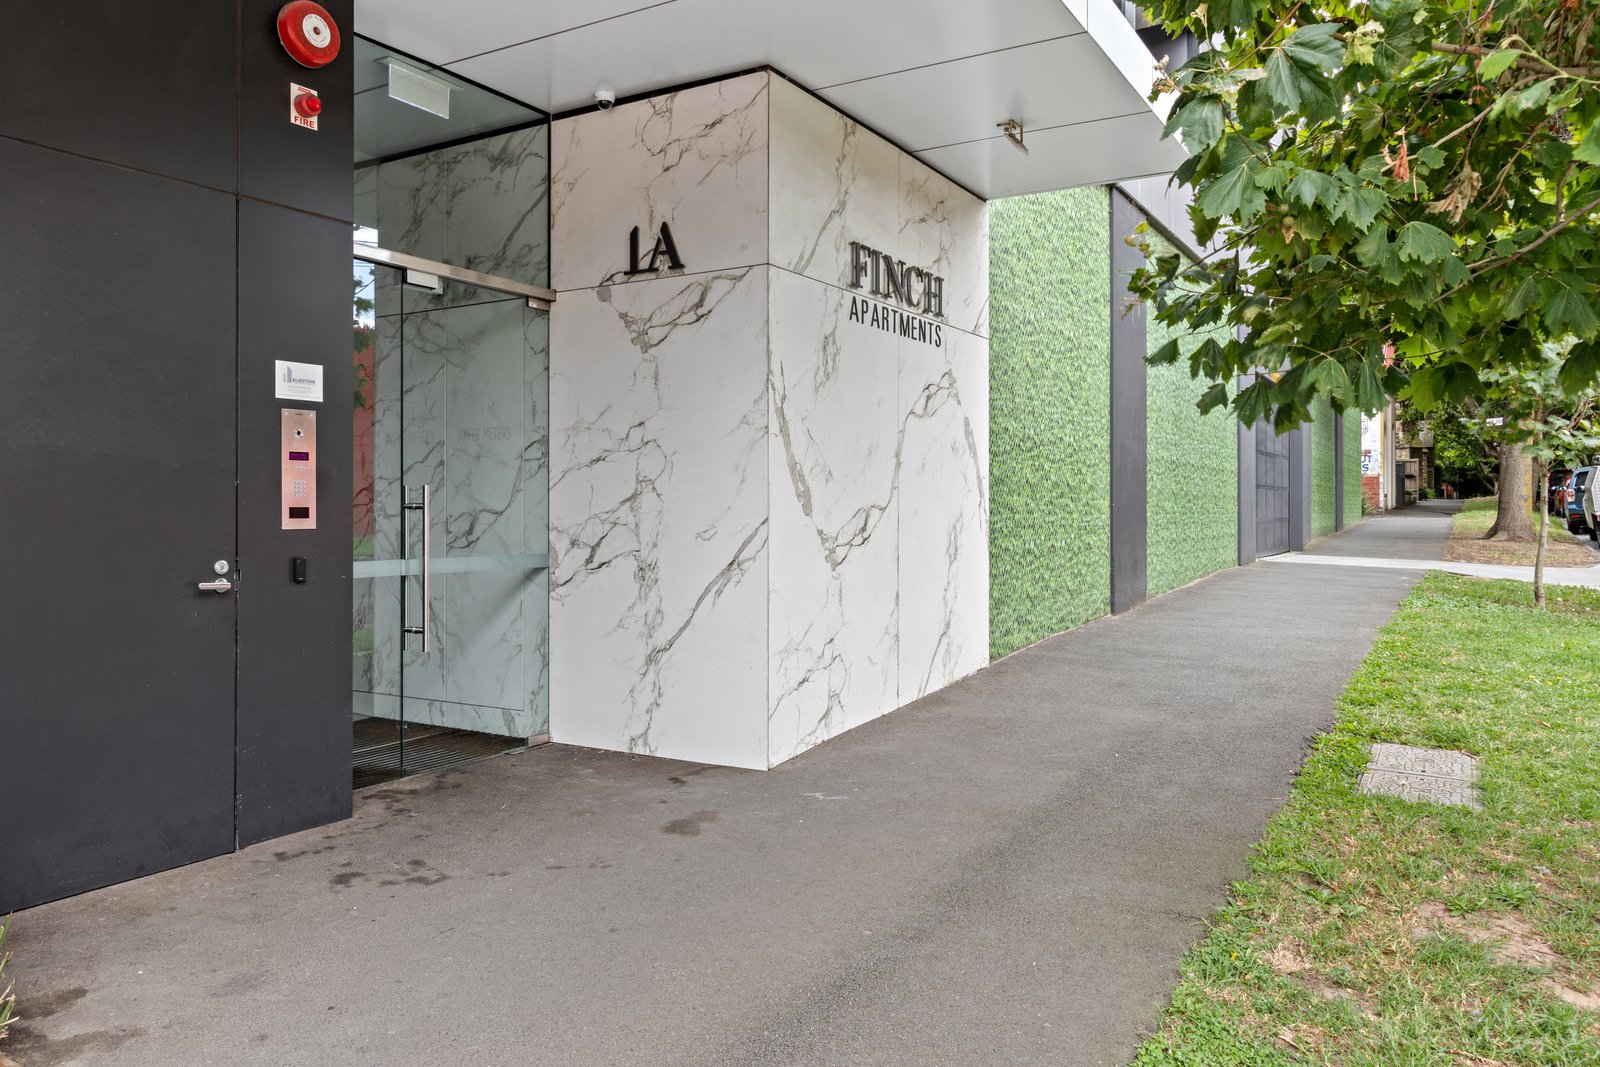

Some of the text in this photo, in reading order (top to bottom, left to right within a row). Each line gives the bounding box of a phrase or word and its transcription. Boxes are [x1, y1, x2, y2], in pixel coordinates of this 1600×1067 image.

[294, 115, 315, 129] FIRE
[849, 240, 944, 318] FINCH
[849, 296, 942, 348] APARTMENTS
[456, 425, 512, 442] WATER METERS
